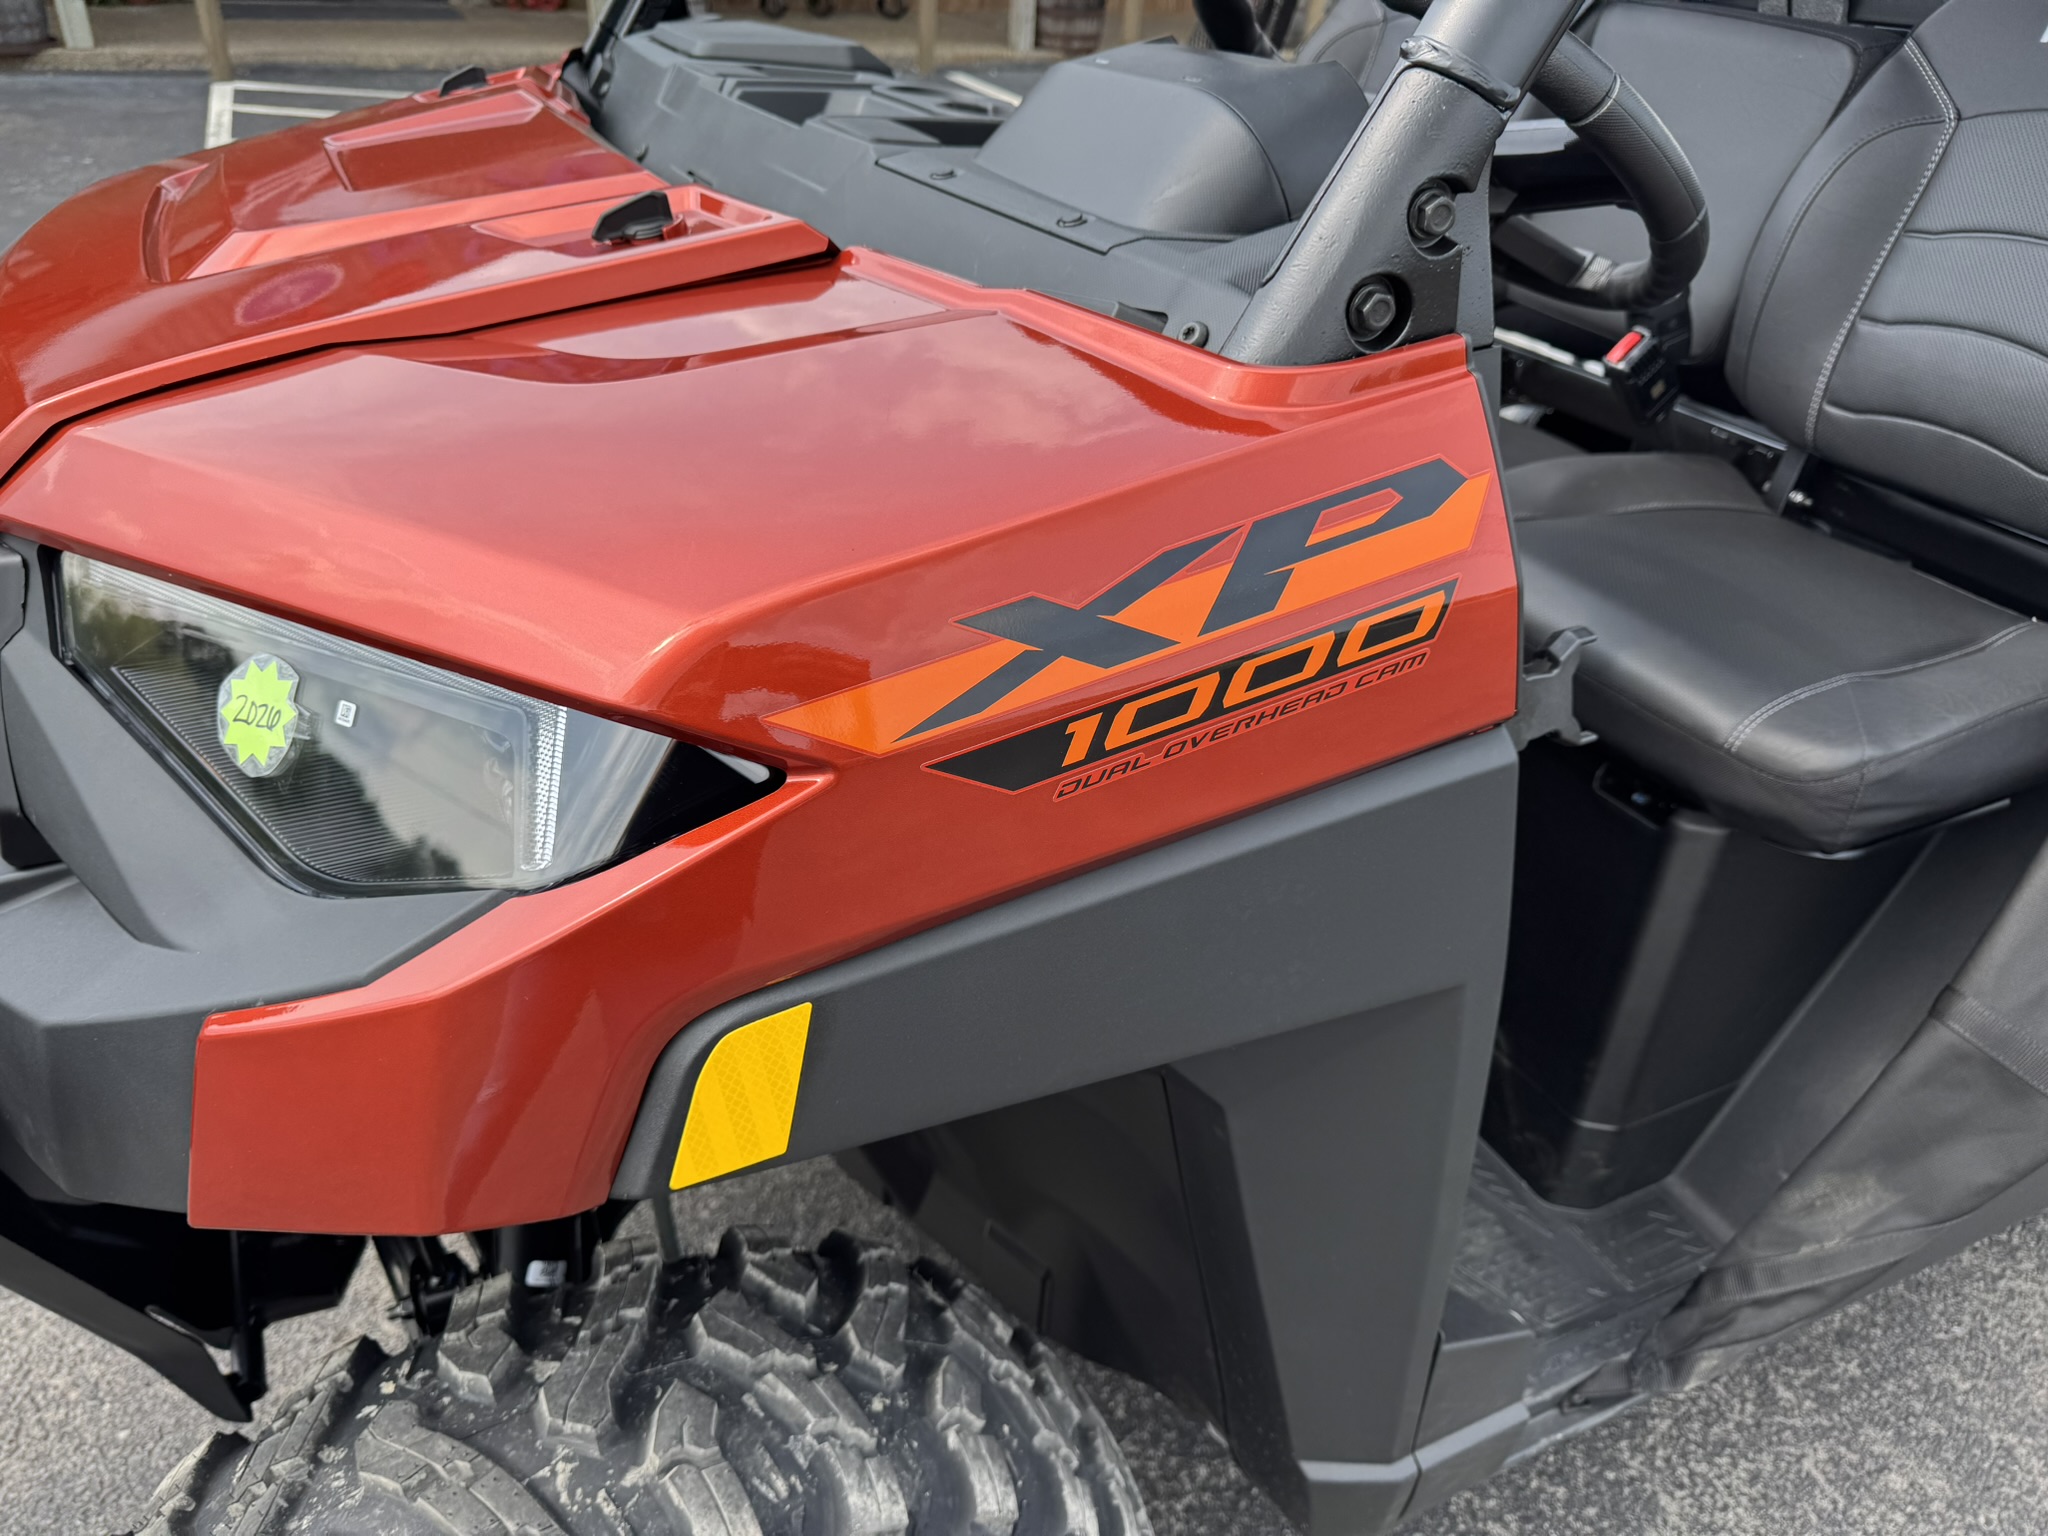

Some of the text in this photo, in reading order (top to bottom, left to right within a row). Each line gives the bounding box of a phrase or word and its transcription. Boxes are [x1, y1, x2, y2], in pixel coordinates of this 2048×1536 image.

[889, 457, 1469, 744] XP
[1062, 590, 1446, 767] 1000
[232, 694, 282, 731] 2026
[1056, 652, 1428, 799] DUAL OVERHEAD CAM
